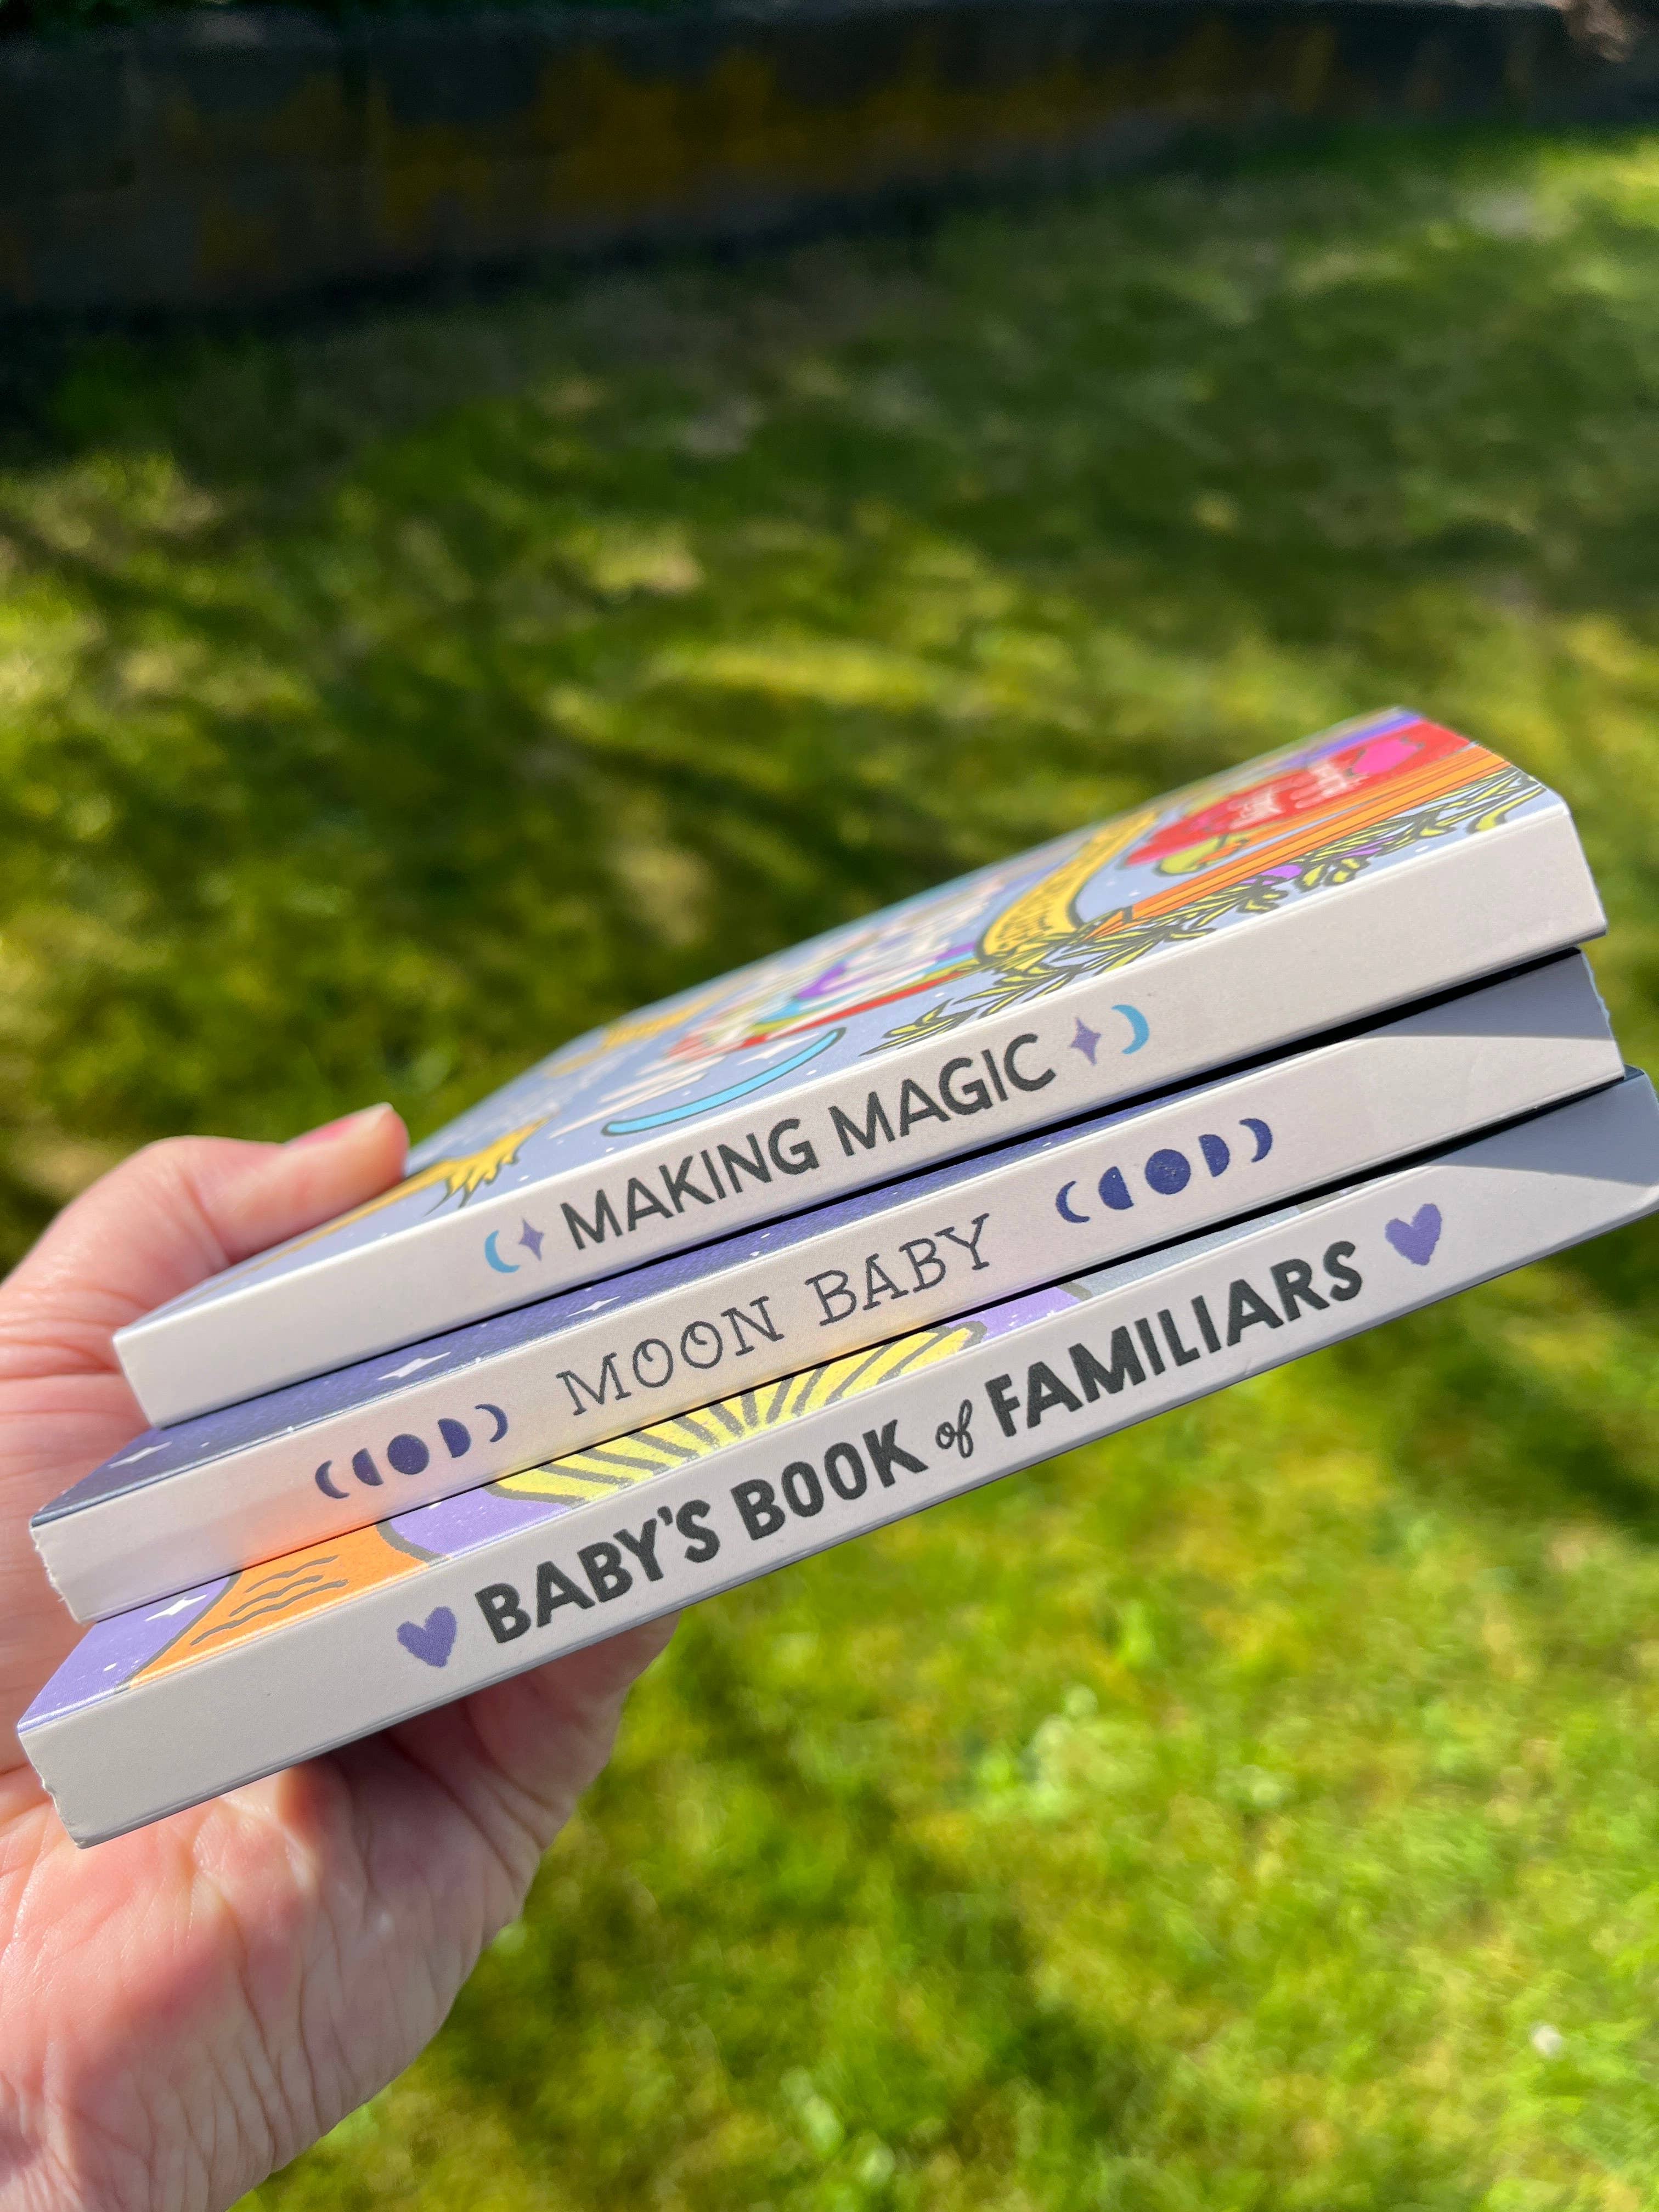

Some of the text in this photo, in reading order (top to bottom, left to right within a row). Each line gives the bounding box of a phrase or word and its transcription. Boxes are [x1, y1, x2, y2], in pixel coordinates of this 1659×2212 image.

[560, 1118, 819, 1250] MAKING
[828, 1033, 1056, 1156] MAGIC
[556, 1213, 990, 1416] MOON BABY
[474, 1240, 1363, 1644] BABY'S BOOK of FAMILIARS
